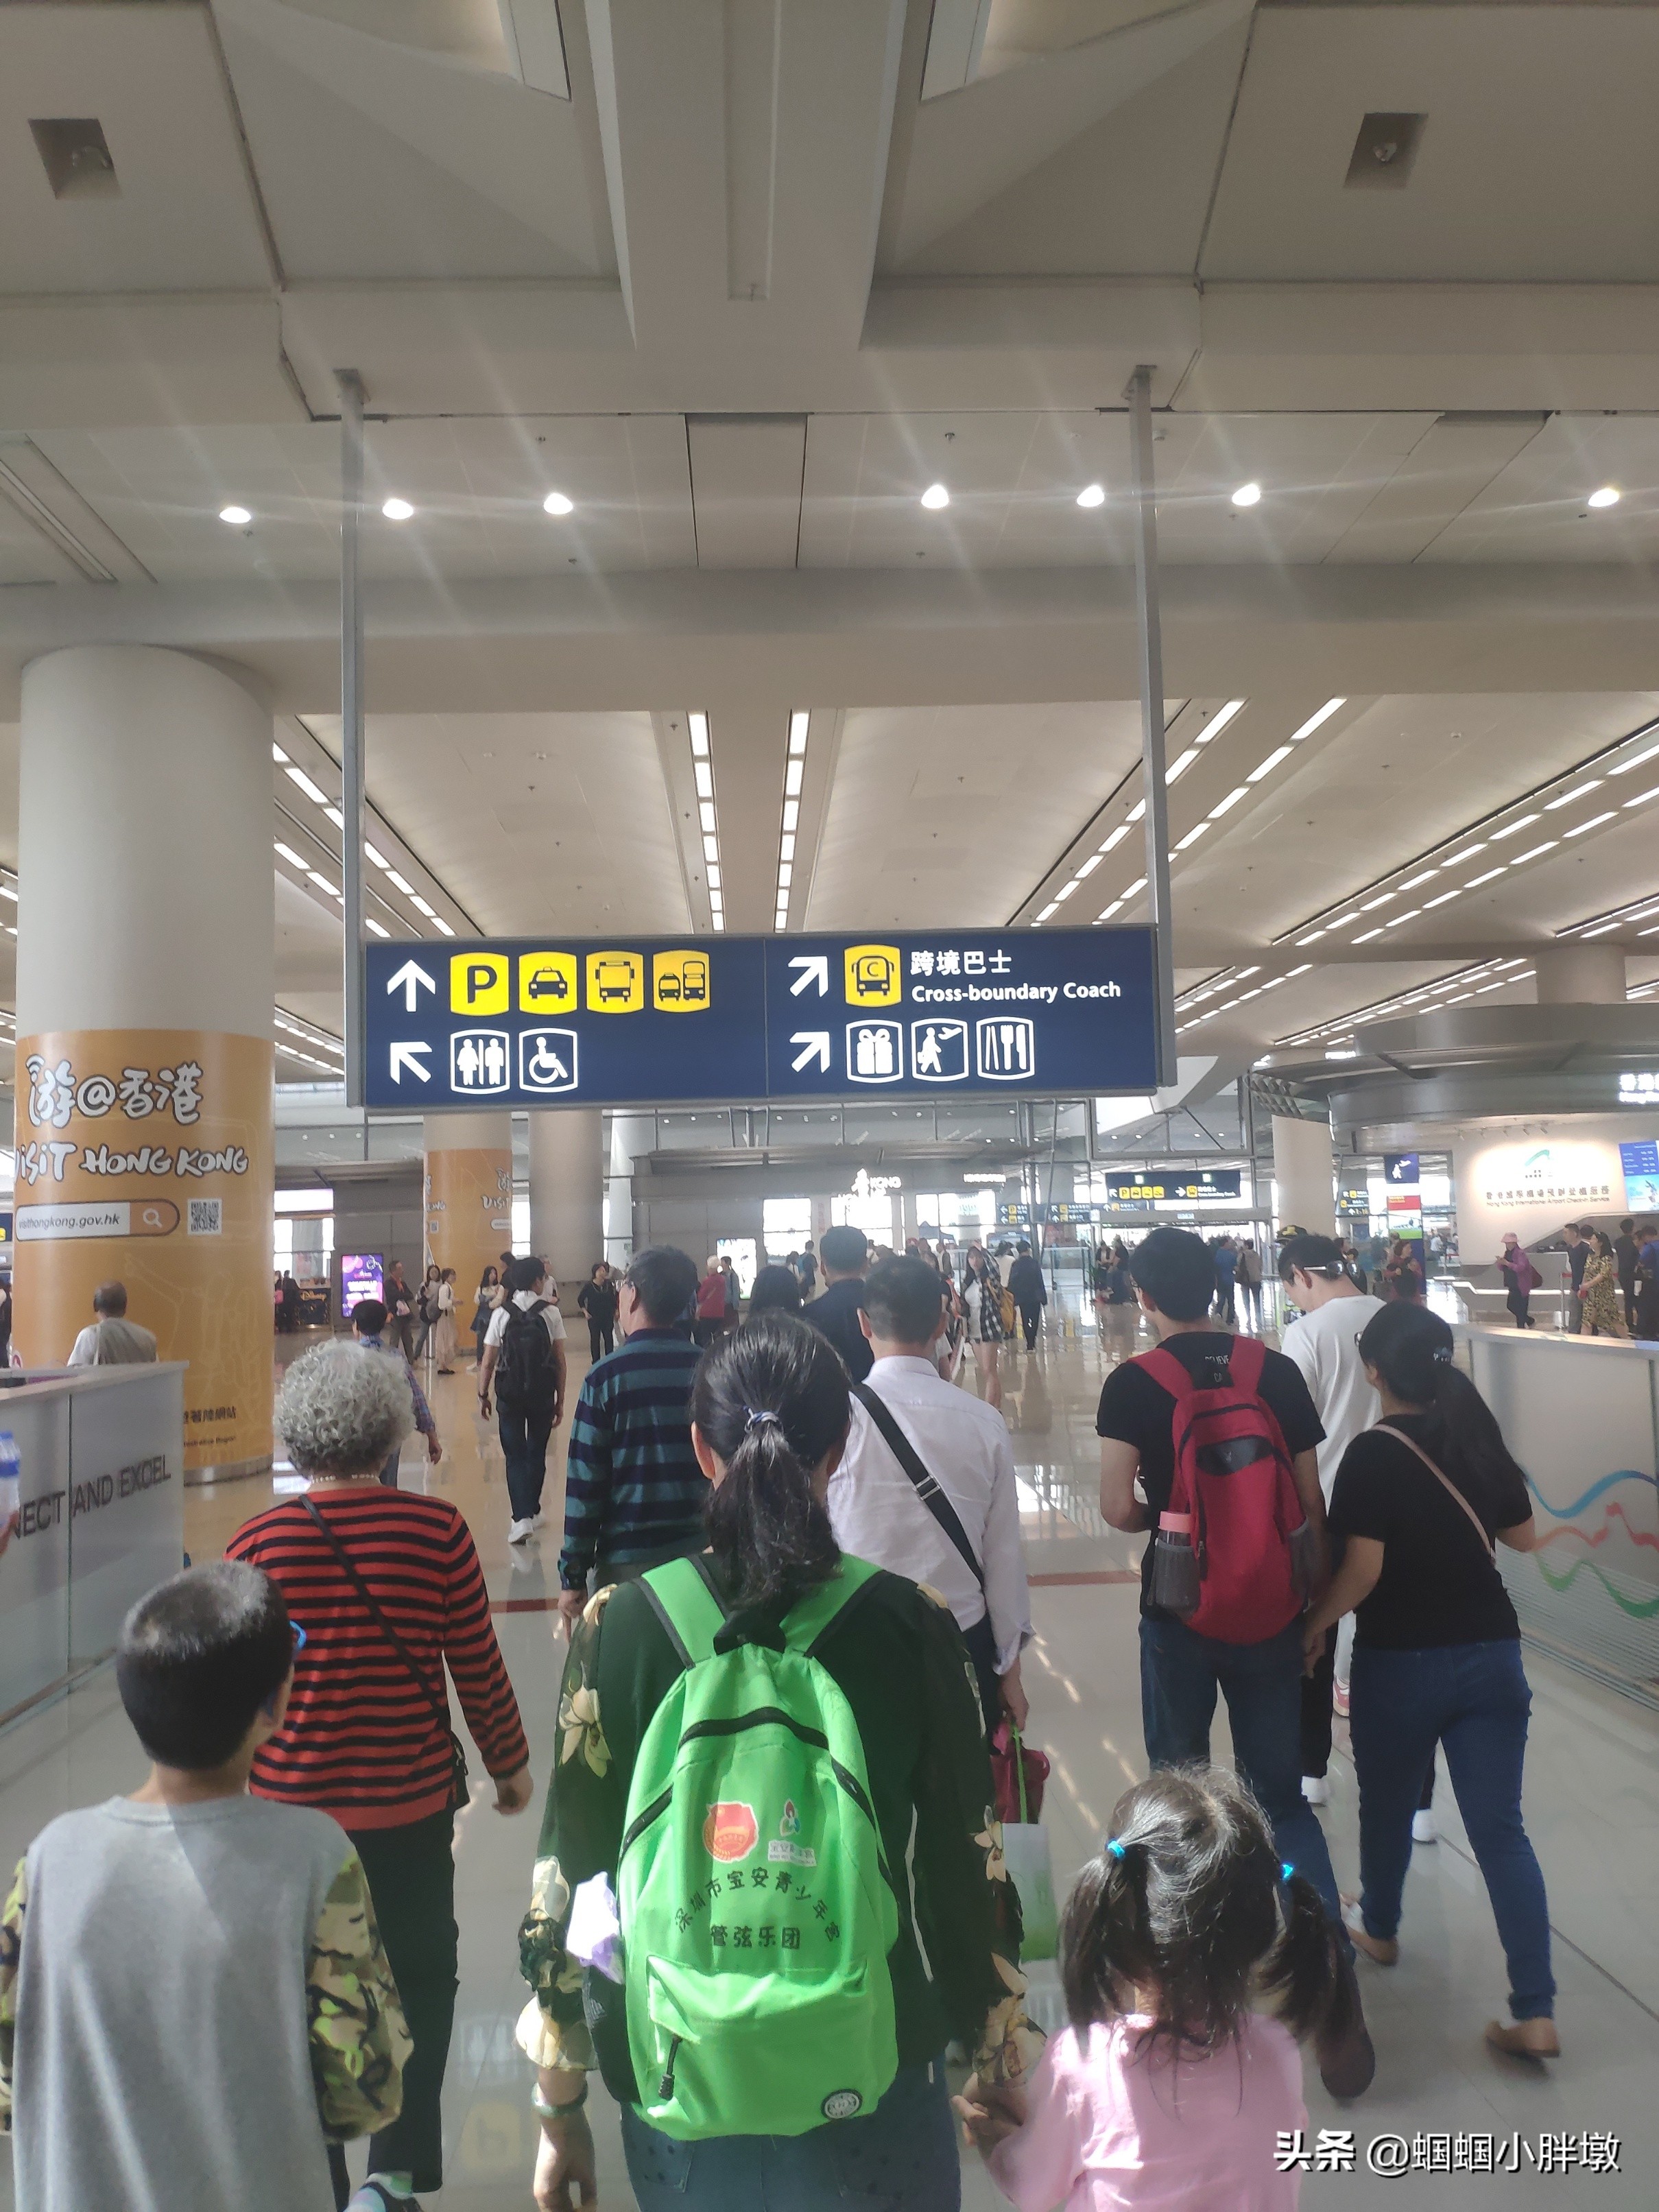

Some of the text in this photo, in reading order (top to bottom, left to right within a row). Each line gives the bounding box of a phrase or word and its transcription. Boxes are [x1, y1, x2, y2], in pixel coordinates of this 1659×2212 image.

[909, 949, 1012, 976] 跨境巴士
[911, 981, 1121, 1003] Cross-boundary Coach
[19, 1211, 121, 1230] visithongkong.gov.hk
[72, 1474, 114, 1517] AND
[119, 1454, 171, 1498] EXCEL
[711, 1924, 801, 1949] 管弦乐团
